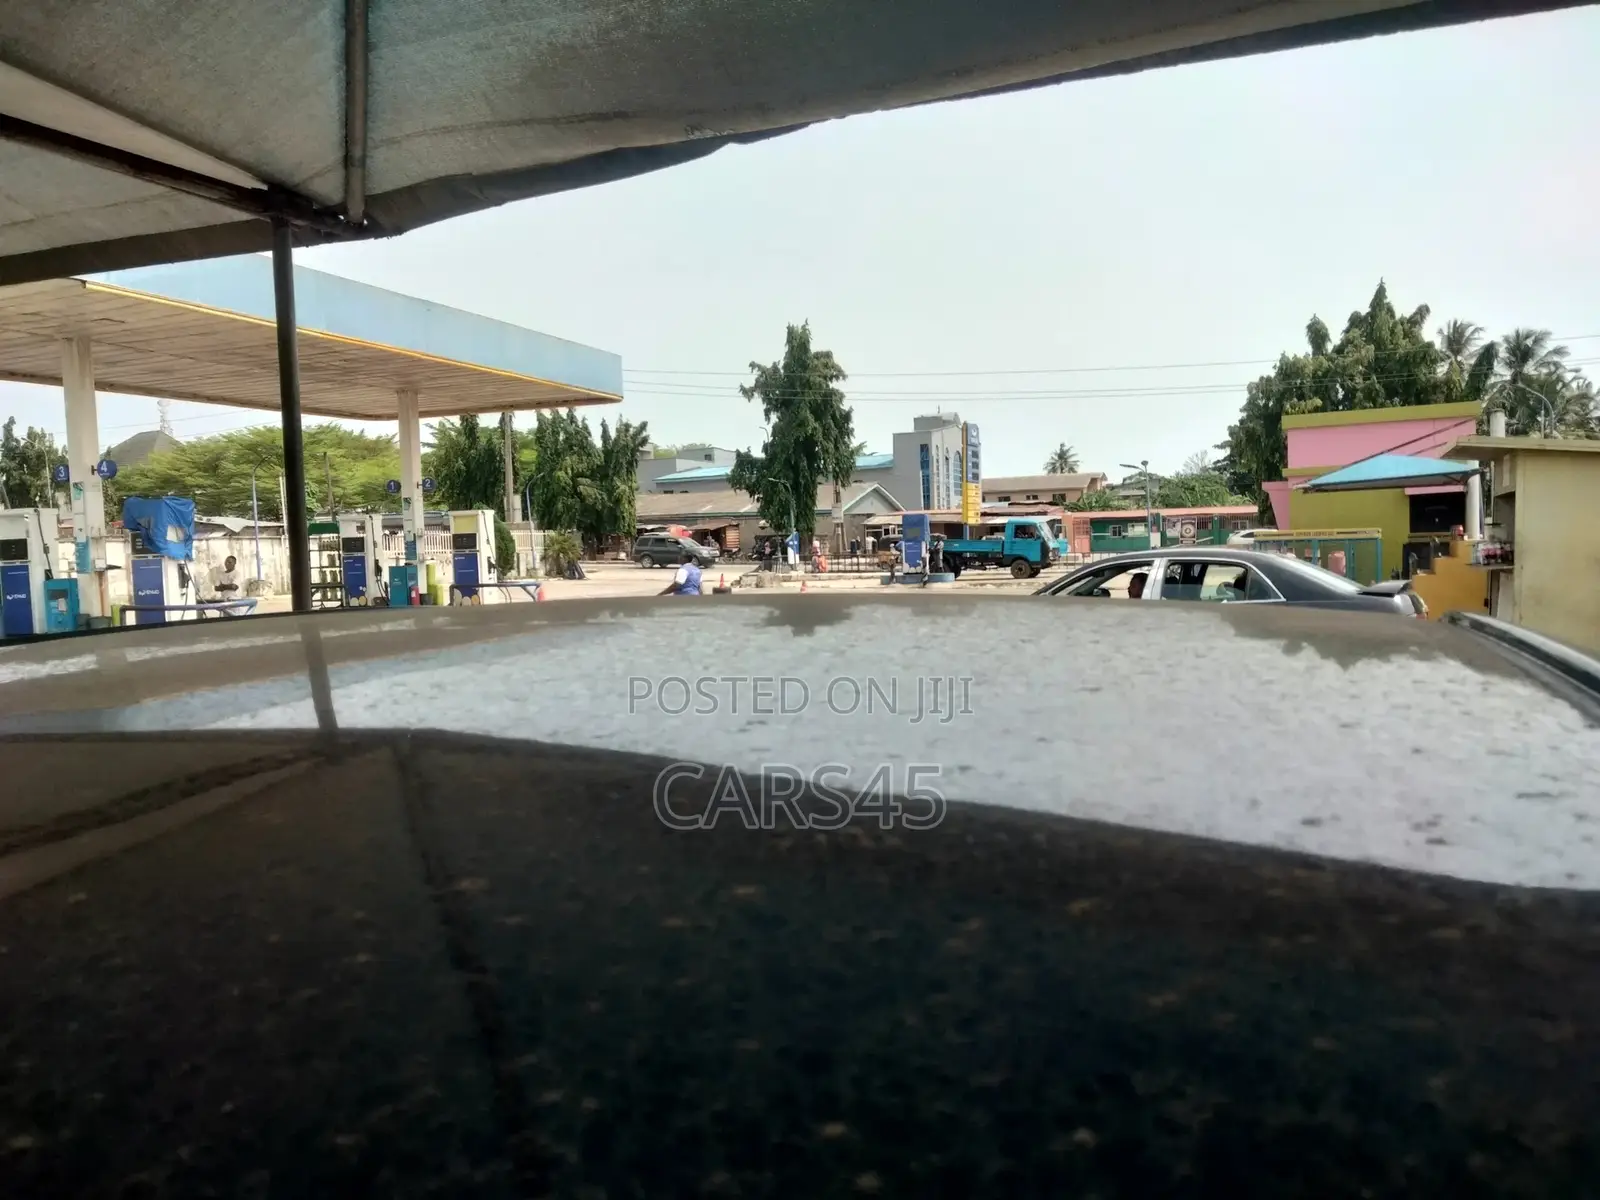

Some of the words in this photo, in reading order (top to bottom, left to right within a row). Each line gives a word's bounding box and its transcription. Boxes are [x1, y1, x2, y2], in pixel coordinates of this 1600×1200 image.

[58, 466, 65, 477] 3
[100, 461, 108, 472] 4
[390, 481, 395, 490] 1
[425, 478, 431, 487] 2
